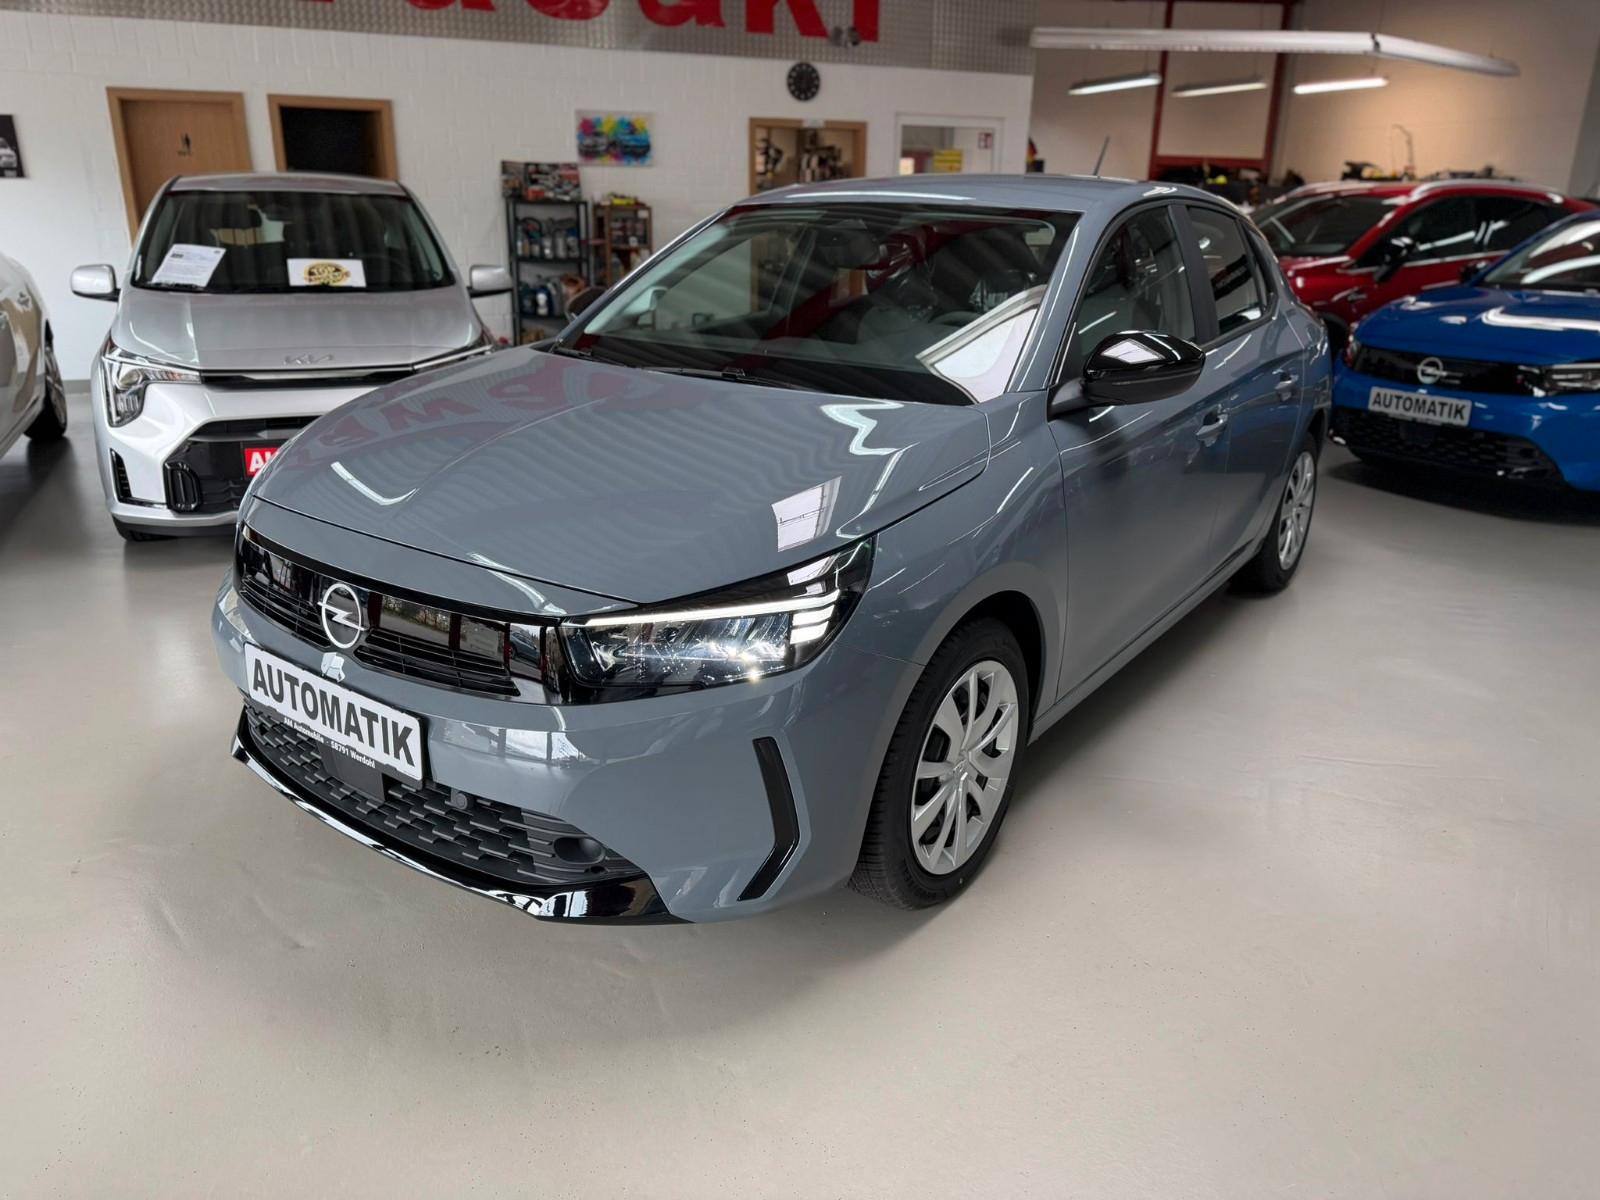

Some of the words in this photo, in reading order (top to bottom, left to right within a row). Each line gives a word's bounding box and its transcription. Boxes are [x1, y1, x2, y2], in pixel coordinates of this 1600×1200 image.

[1372, 391, 1466, 420] AUTOMATIK
[253, 658, 416, 768] AUTOMATIK
[349, 749, 376, 769] Werdohl
